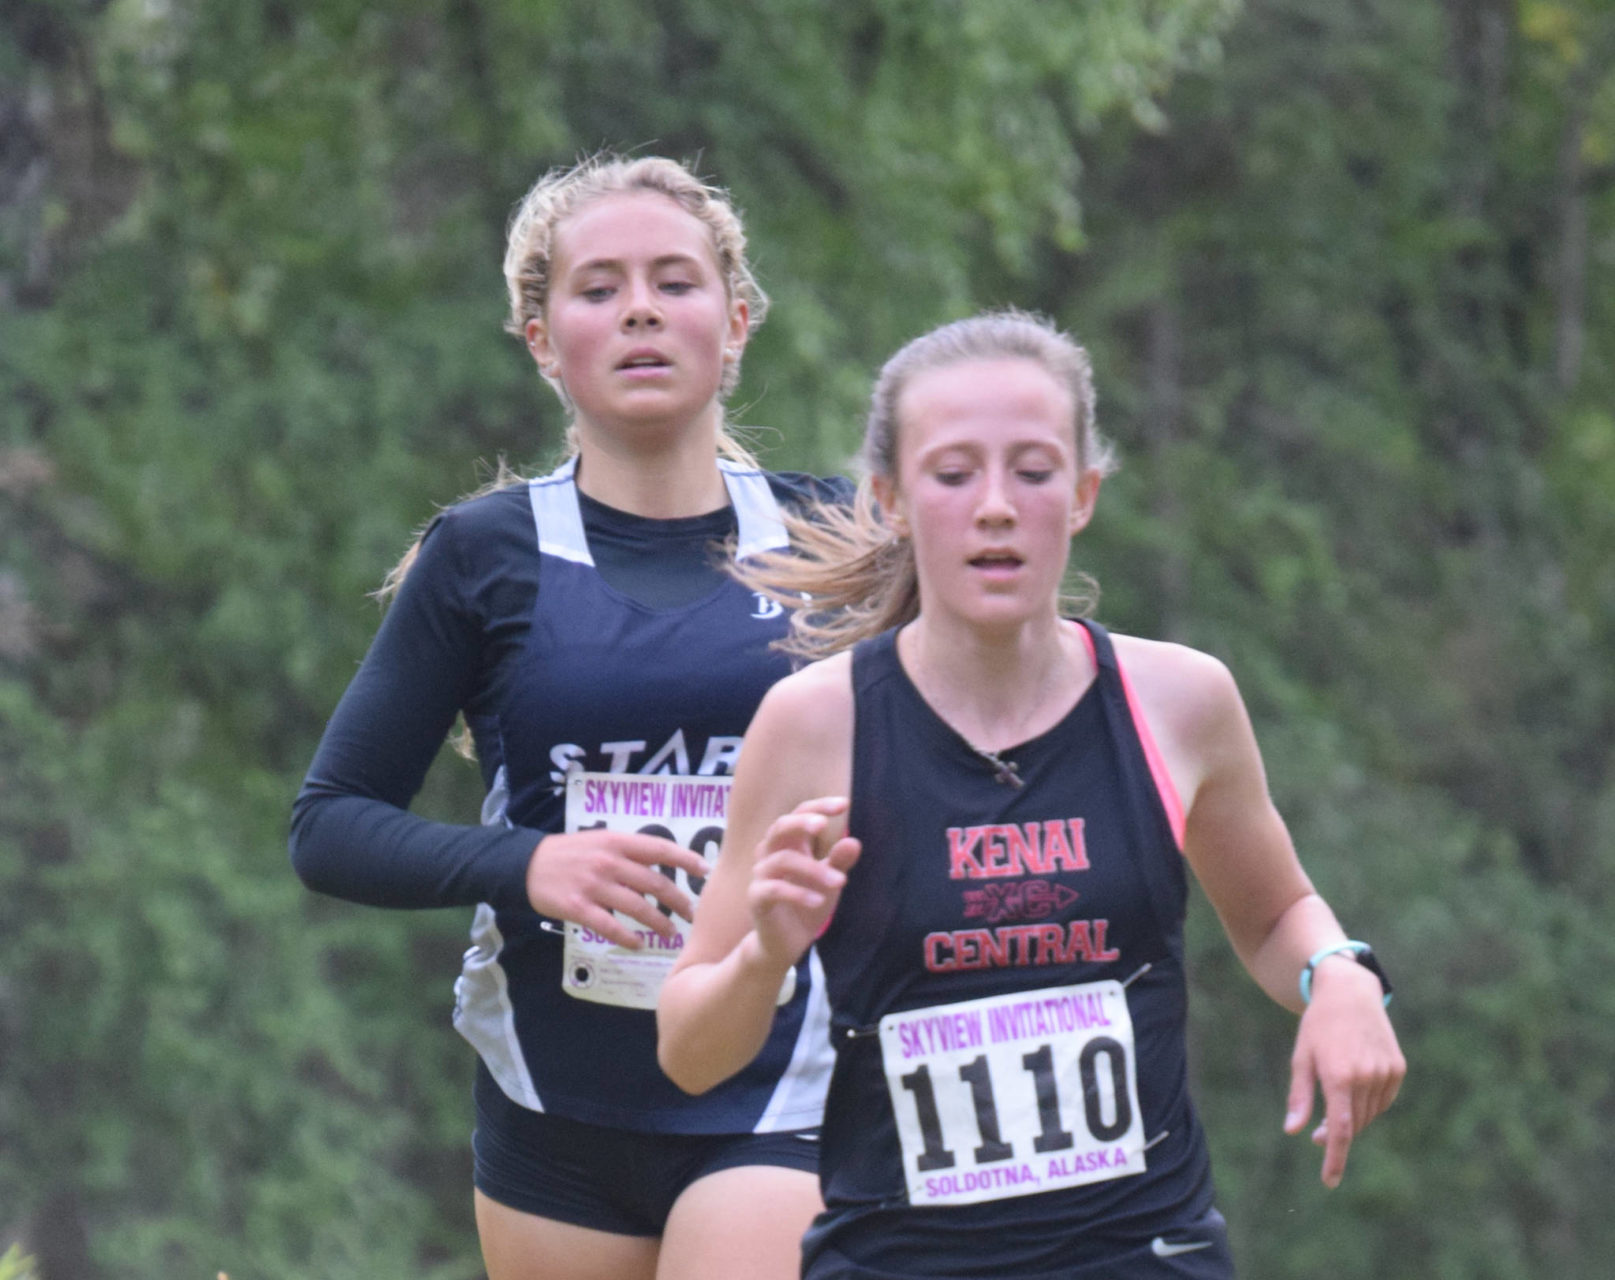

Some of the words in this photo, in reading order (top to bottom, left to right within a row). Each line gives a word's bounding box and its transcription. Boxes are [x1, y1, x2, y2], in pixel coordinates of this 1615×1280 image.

[585, 779, 666, 817] SKYVIEW
[946, 817, 1090, 879] KENAI
[924, 918, 1120, 973] CENTRAL
[899, 1009, 983, 1059] SKYVIEW
[988, 992, 1111, 1044] INVITATIONAL
[902, 1036, 1132, 1172] 1110
[925, 1164, 1041, 1198] SOLDOTNA,
[1047, 1147, 1128, 1180] ALASKA
